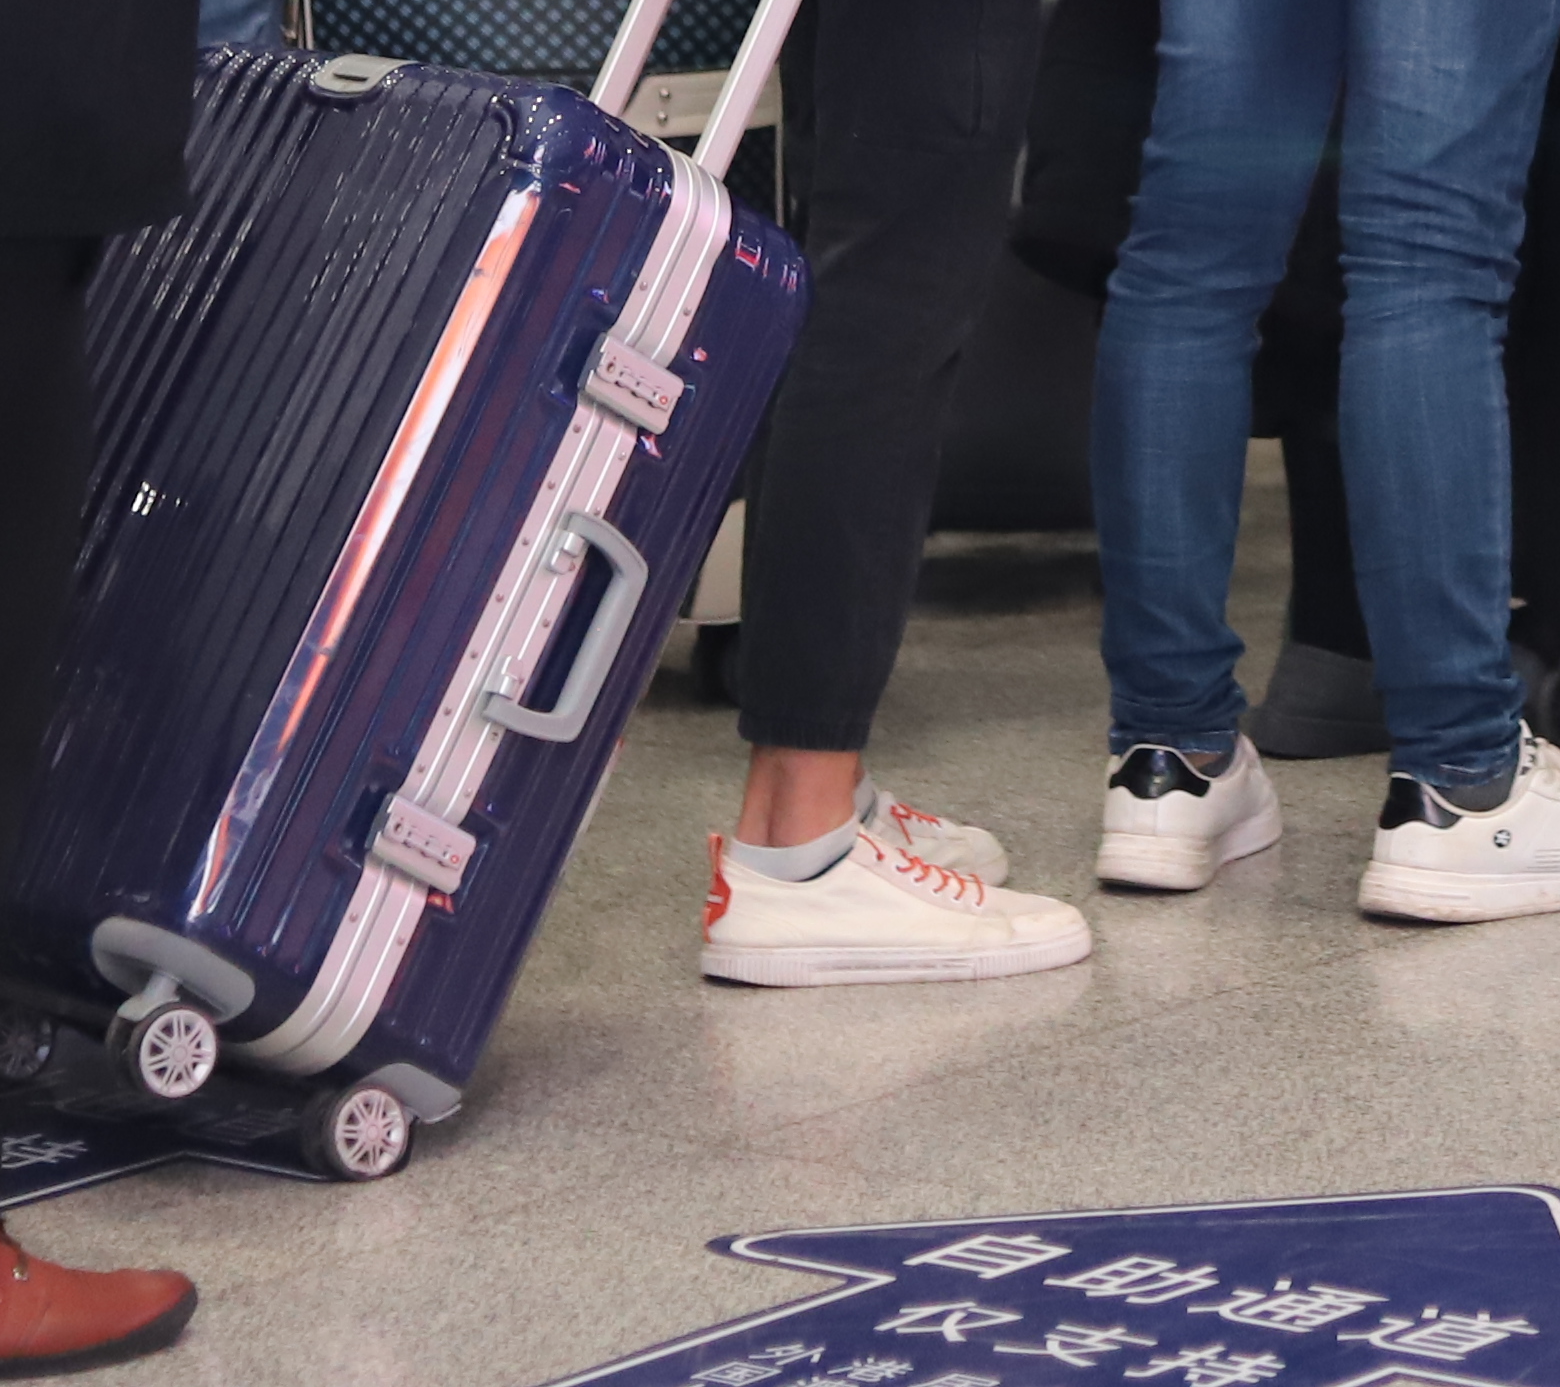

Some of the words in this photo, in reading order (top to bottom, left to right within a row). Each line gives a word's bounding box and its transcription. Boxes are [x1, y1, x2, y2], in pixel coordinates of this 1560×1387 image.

[875, 1301, 1286, 1387] 仅支持
[903, 1235, 1539, 1360] 自助通道
